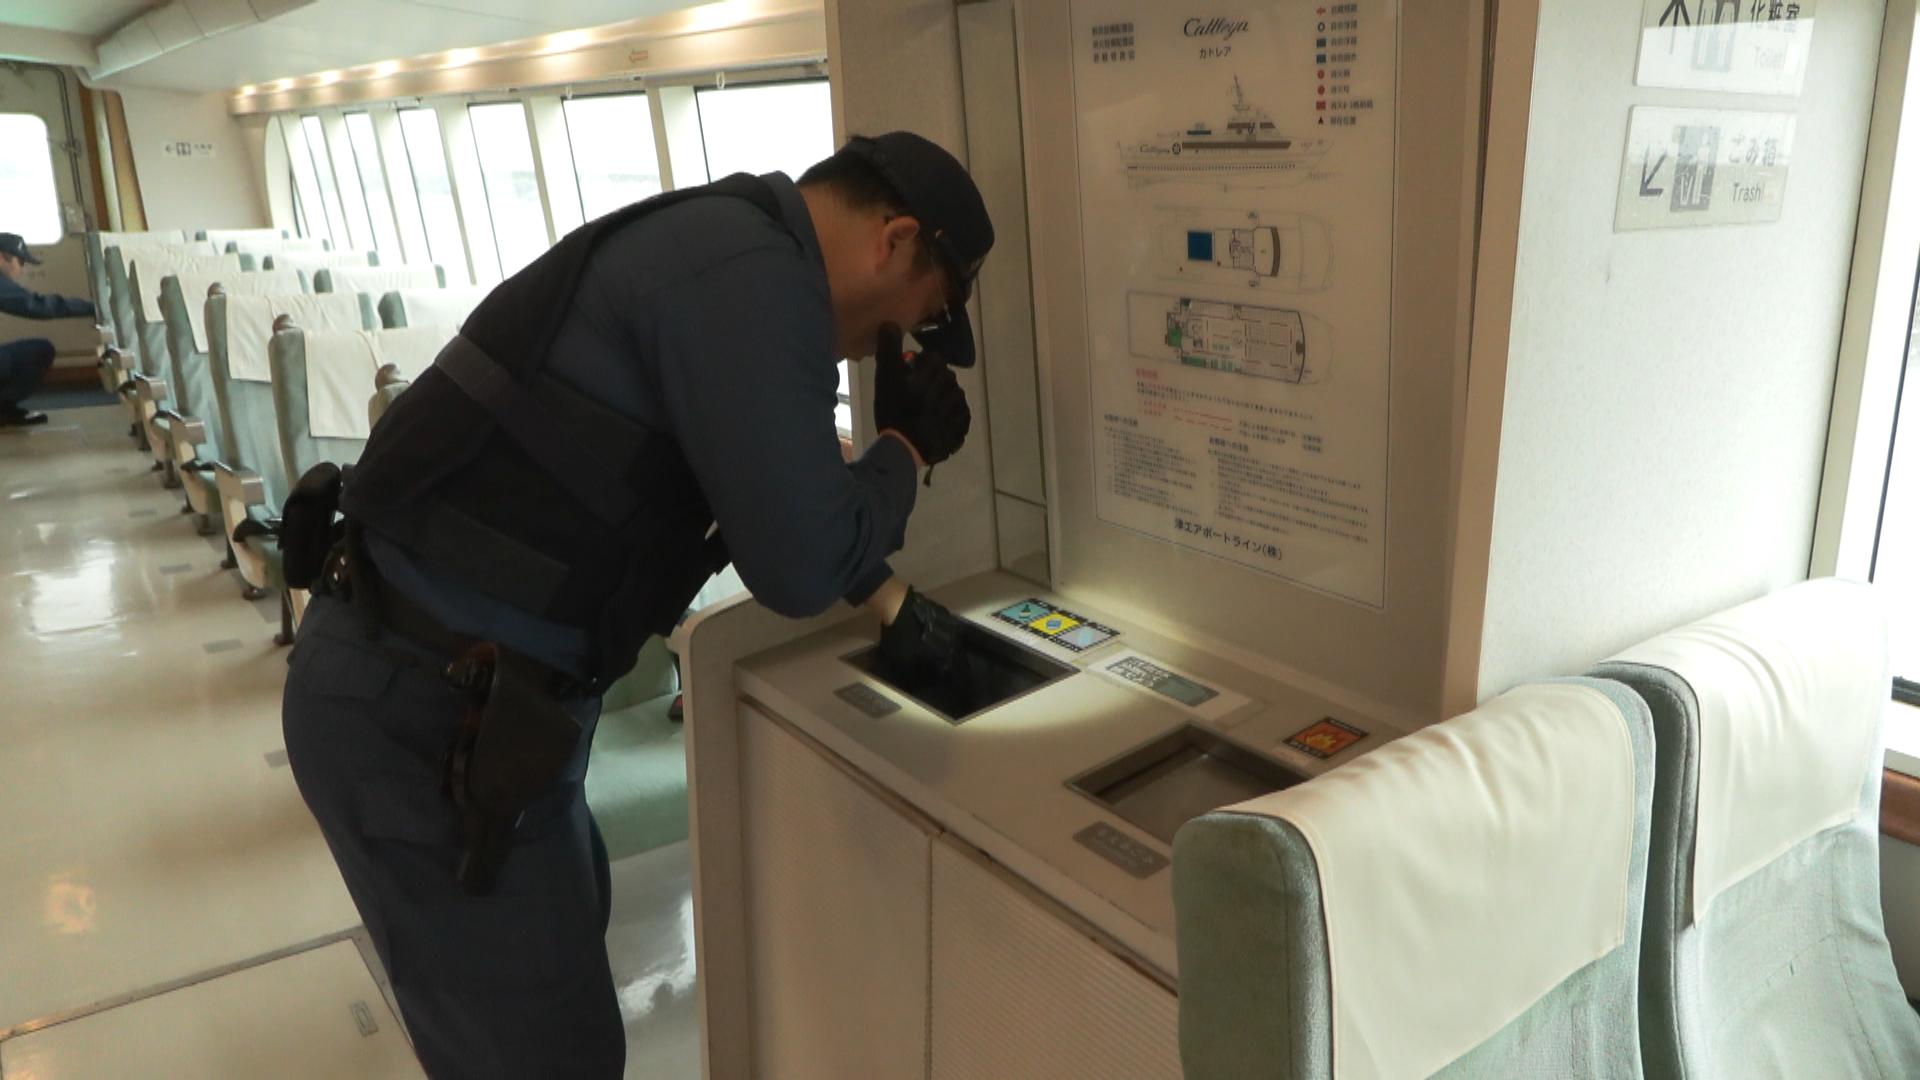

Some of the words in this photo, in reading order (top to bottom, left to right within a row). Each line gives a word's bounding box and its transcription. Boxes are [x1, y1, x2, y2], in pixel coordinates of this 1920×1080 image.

[1199, 46, 1232, 59] カトレア
[1732, 181, 1762, 204] Trash
